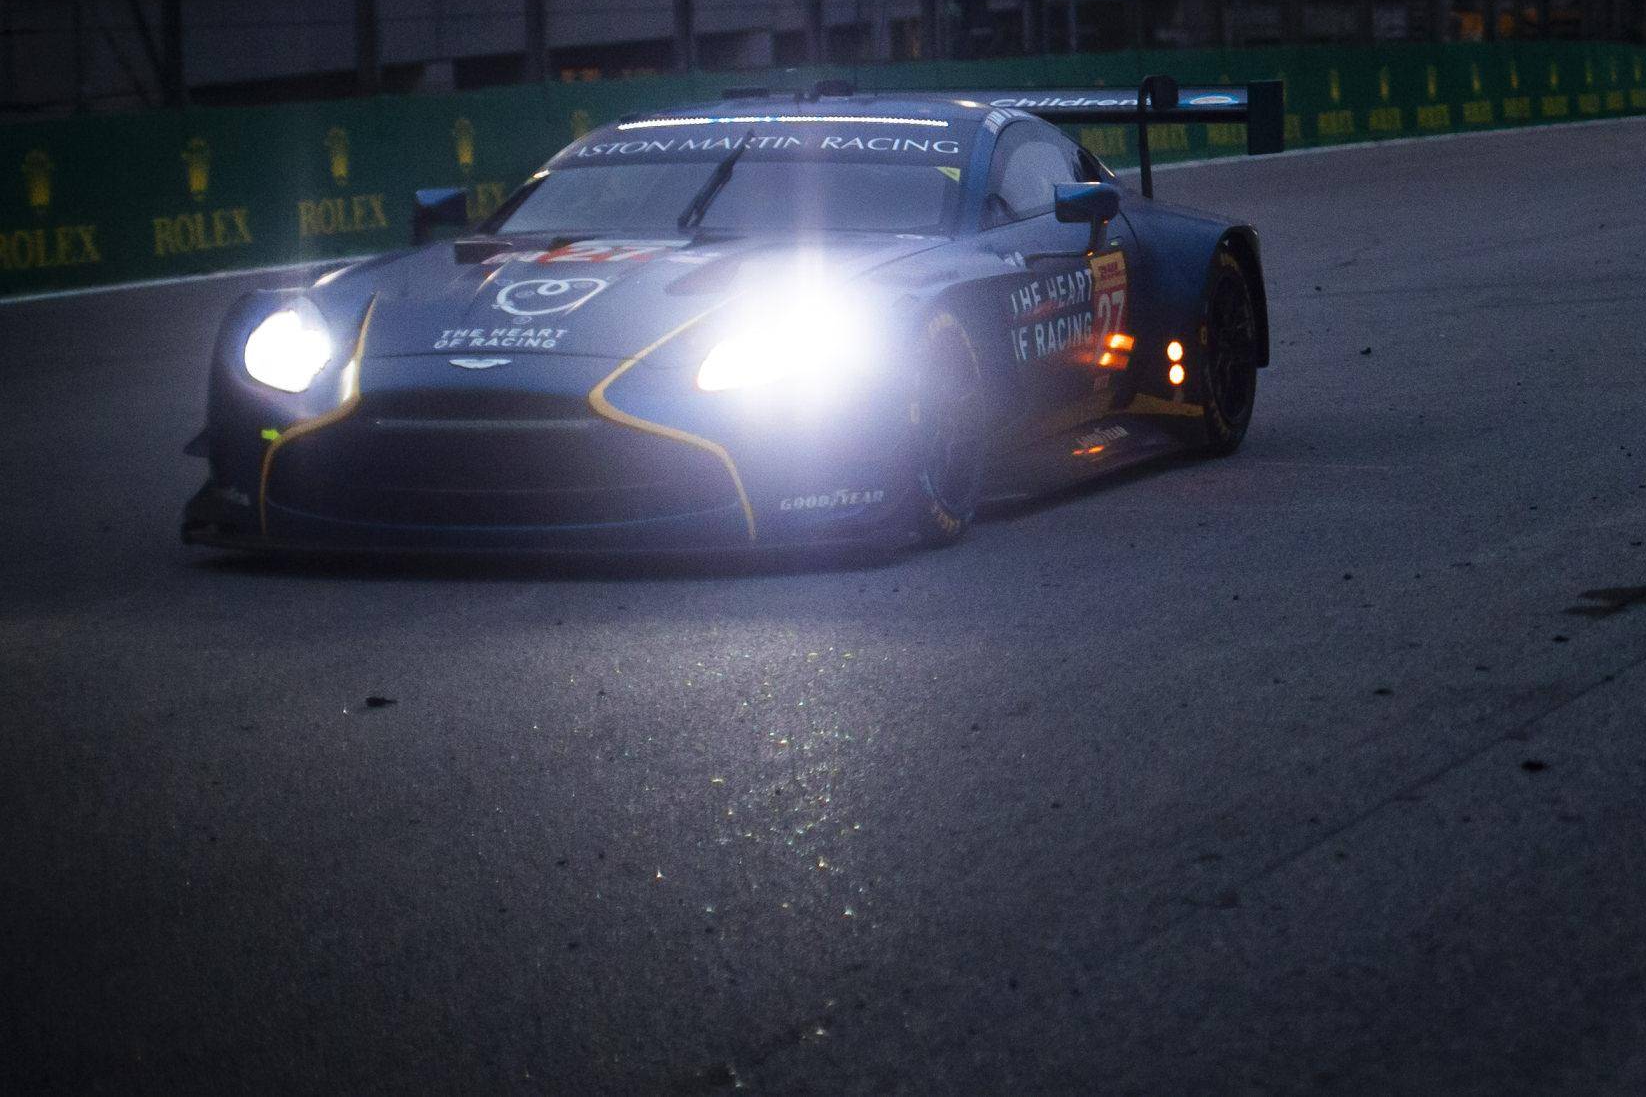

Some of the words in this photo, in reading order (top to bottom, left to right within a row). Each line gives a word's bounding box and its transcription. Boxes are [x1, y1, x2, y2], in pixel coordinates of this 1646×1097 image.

[990, 98, 1152, 107] Children
[820, 136, 959, 154] RACING
[297, 194, 390, 237] ROLEX
[153, 207, 254, 258] ROLEX
[1045, 268, 1093, 308] HEART
[433, 338, 463, 349] OF
[469, 337, 557, 349] RACING
[441, 329, 485, 338] THE
[490, 328, 568, 338] HEART
[1034, 311, 1093, 357] RACING
